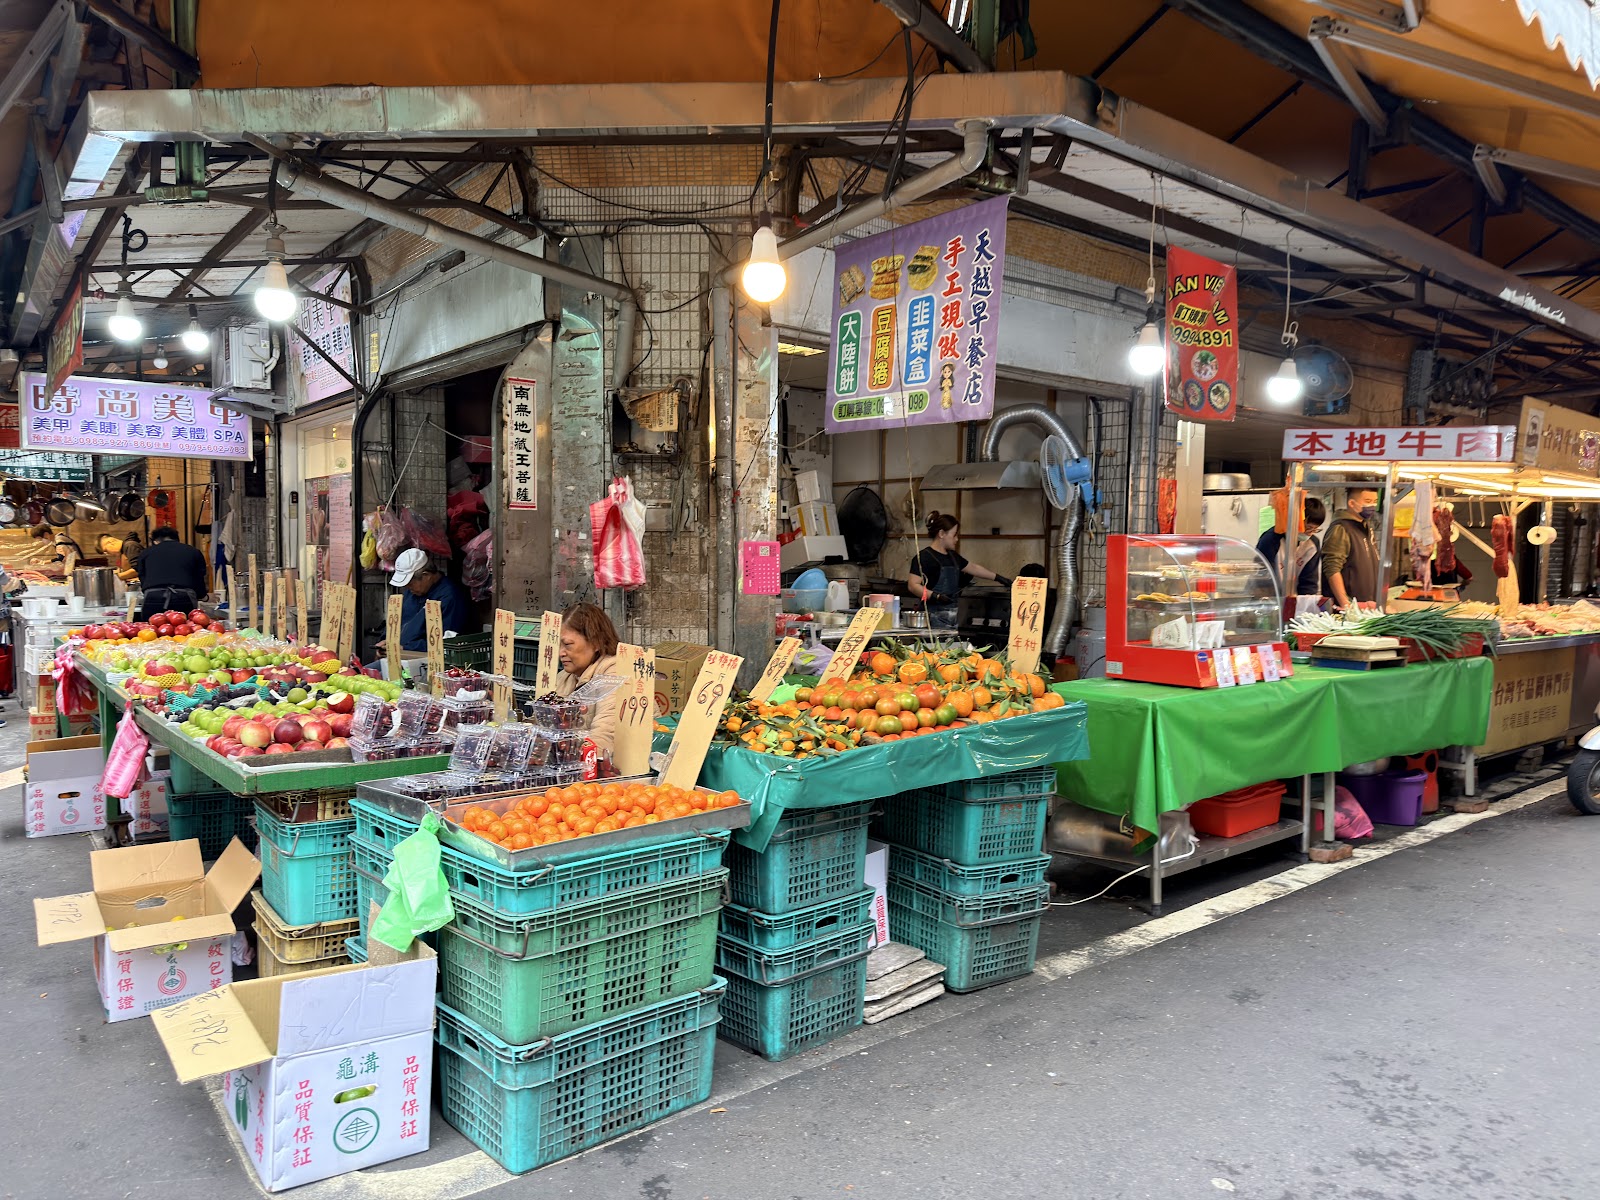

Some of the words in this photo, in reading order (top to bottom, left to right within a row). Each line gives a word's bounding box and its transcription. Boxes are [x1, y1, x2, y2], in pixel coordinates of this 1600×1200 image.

[937, 236, 965, 361] 手工現做
[964, 230, 996, 405] 天越早餐店
[839, 316, 858, 391] 大陸餅
[873, 310, 892, 386] 豆腐捲
[908, 301, 930, 382] 韭菜盒
[33, 416, 69, 432] 美甲
[81, 420, 117, 435] 美睫
[127, 423, 162, 438] 美容
[172, 426, 206, 441] 美體
[213, 429, 243, 442] SPA
[514, 386, 531, 502] 南無地藏王菩薩
[1293, 431, 1503, 458] 本地牛肉
[619, 696, 649, 727] 199
[117, 952, 135, 1010] 質保證
[207, 936, 224, 990] 級包裝
[292, 1079, 314, 1168] 品質保証
[400, 1055, 420, 1139] 品質保証
